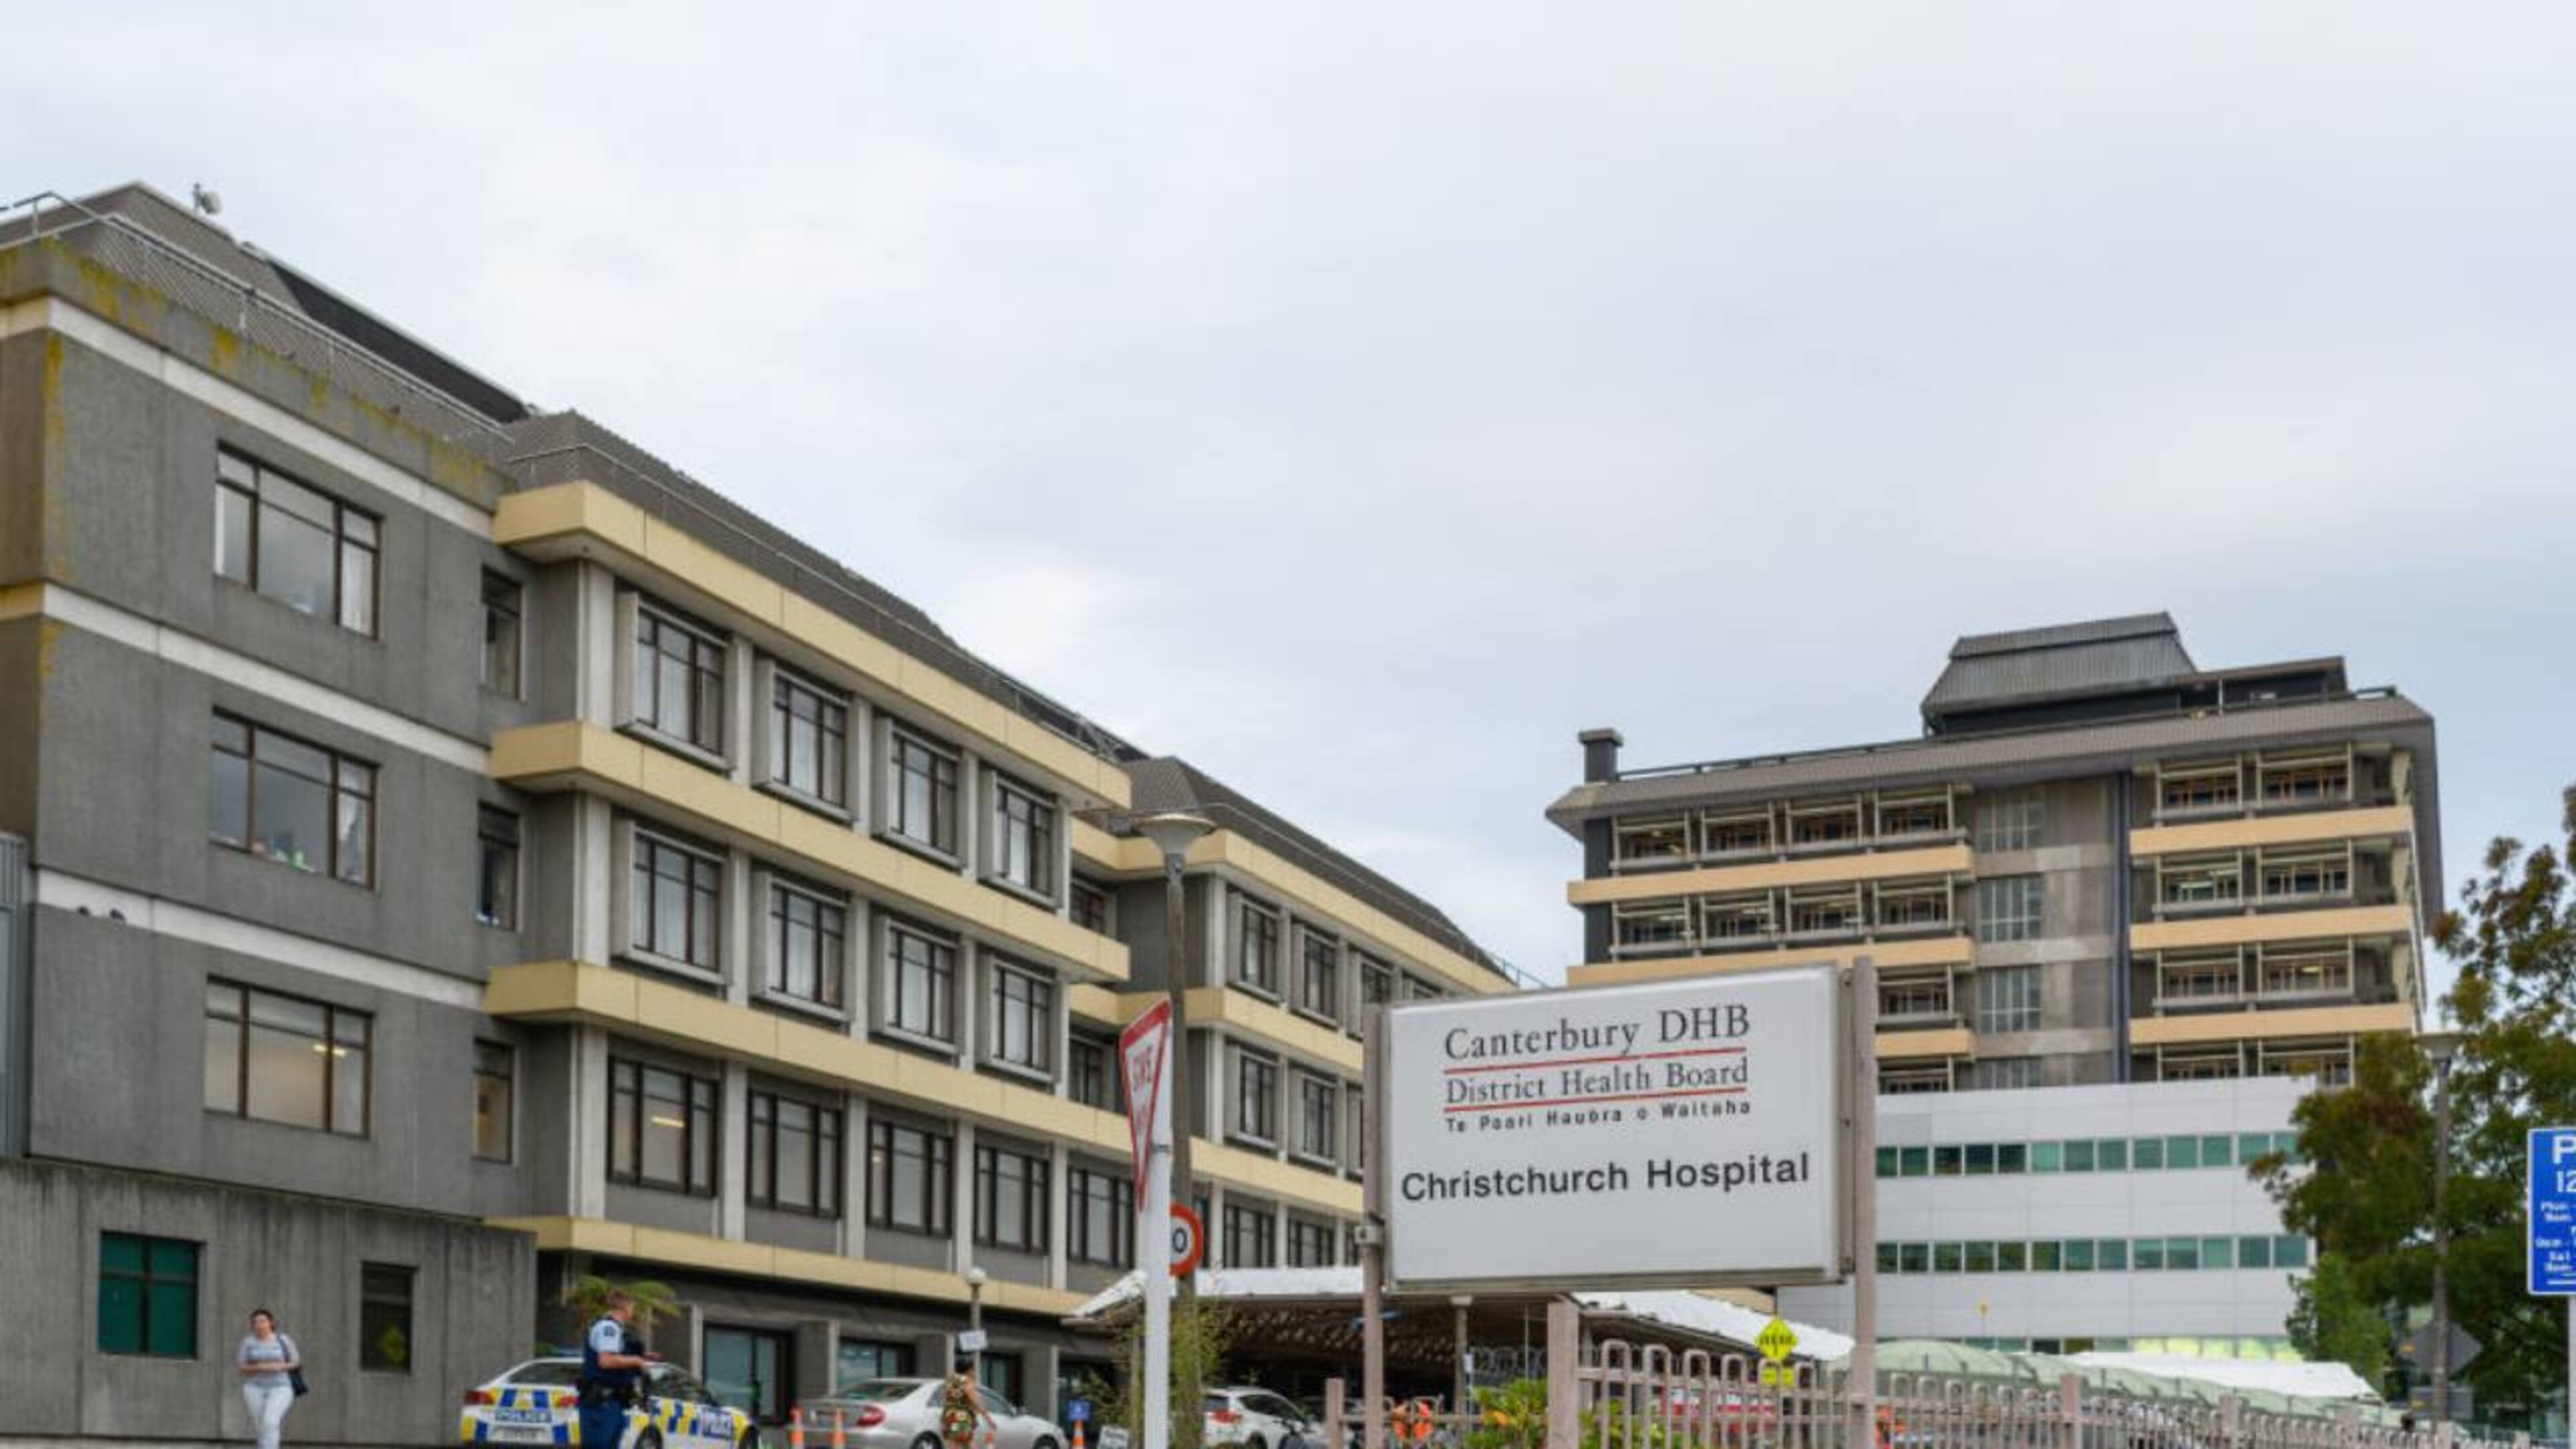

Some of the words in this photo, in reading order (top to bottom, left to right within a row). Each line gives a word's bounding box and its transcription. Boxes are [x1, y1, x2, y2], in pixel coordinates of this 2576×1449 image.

[1445, 1017, 1641, 1057] Canterbury
[1658, 1004, 1750, 1043] DHB
[1447, 1073, 1546, 1104] District
[1561, 1063, 1650, 1095] Health
[1666, 1056, 1748, 1087] Board
[1446, 1118, 1466, 1132] Te
[1637, 1108, 1648, 1120] o
[1401, 1162, 1627, 1201] Christchurch
[1648, 1152, 1809, 1193] Hospital
